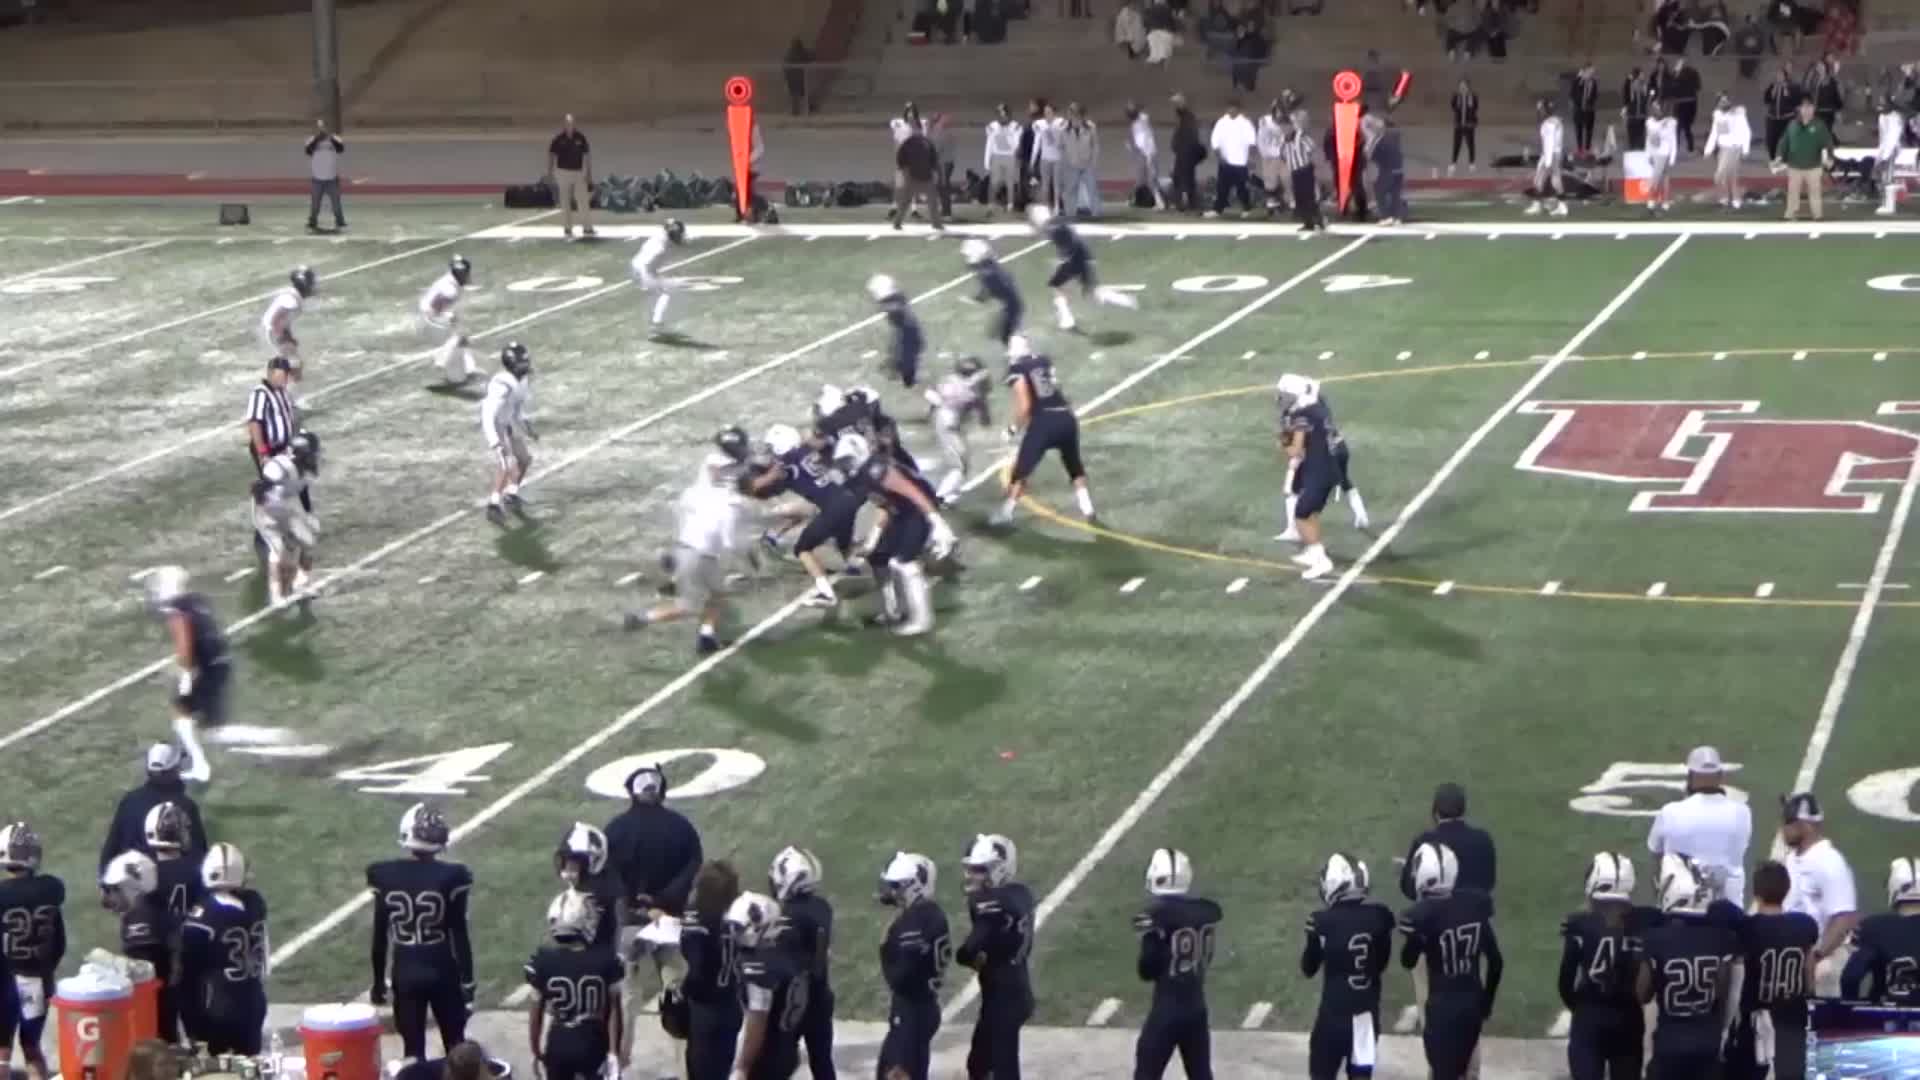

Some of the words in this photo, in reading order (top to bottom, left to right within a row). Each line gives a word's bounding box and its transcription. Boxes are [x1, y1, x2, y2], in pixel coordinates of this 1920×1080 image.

[385, 890, 447, 945] 22
[1346, 932, 1374, 991] 3
[1439, 922, 1481, 977] 17
[1759, 946, 1805, 1001] 10
[545, 974, 607, 1029] 20
[1662, 955, 1721, 1017] 25
[76, 1017, 100, 1041] G
